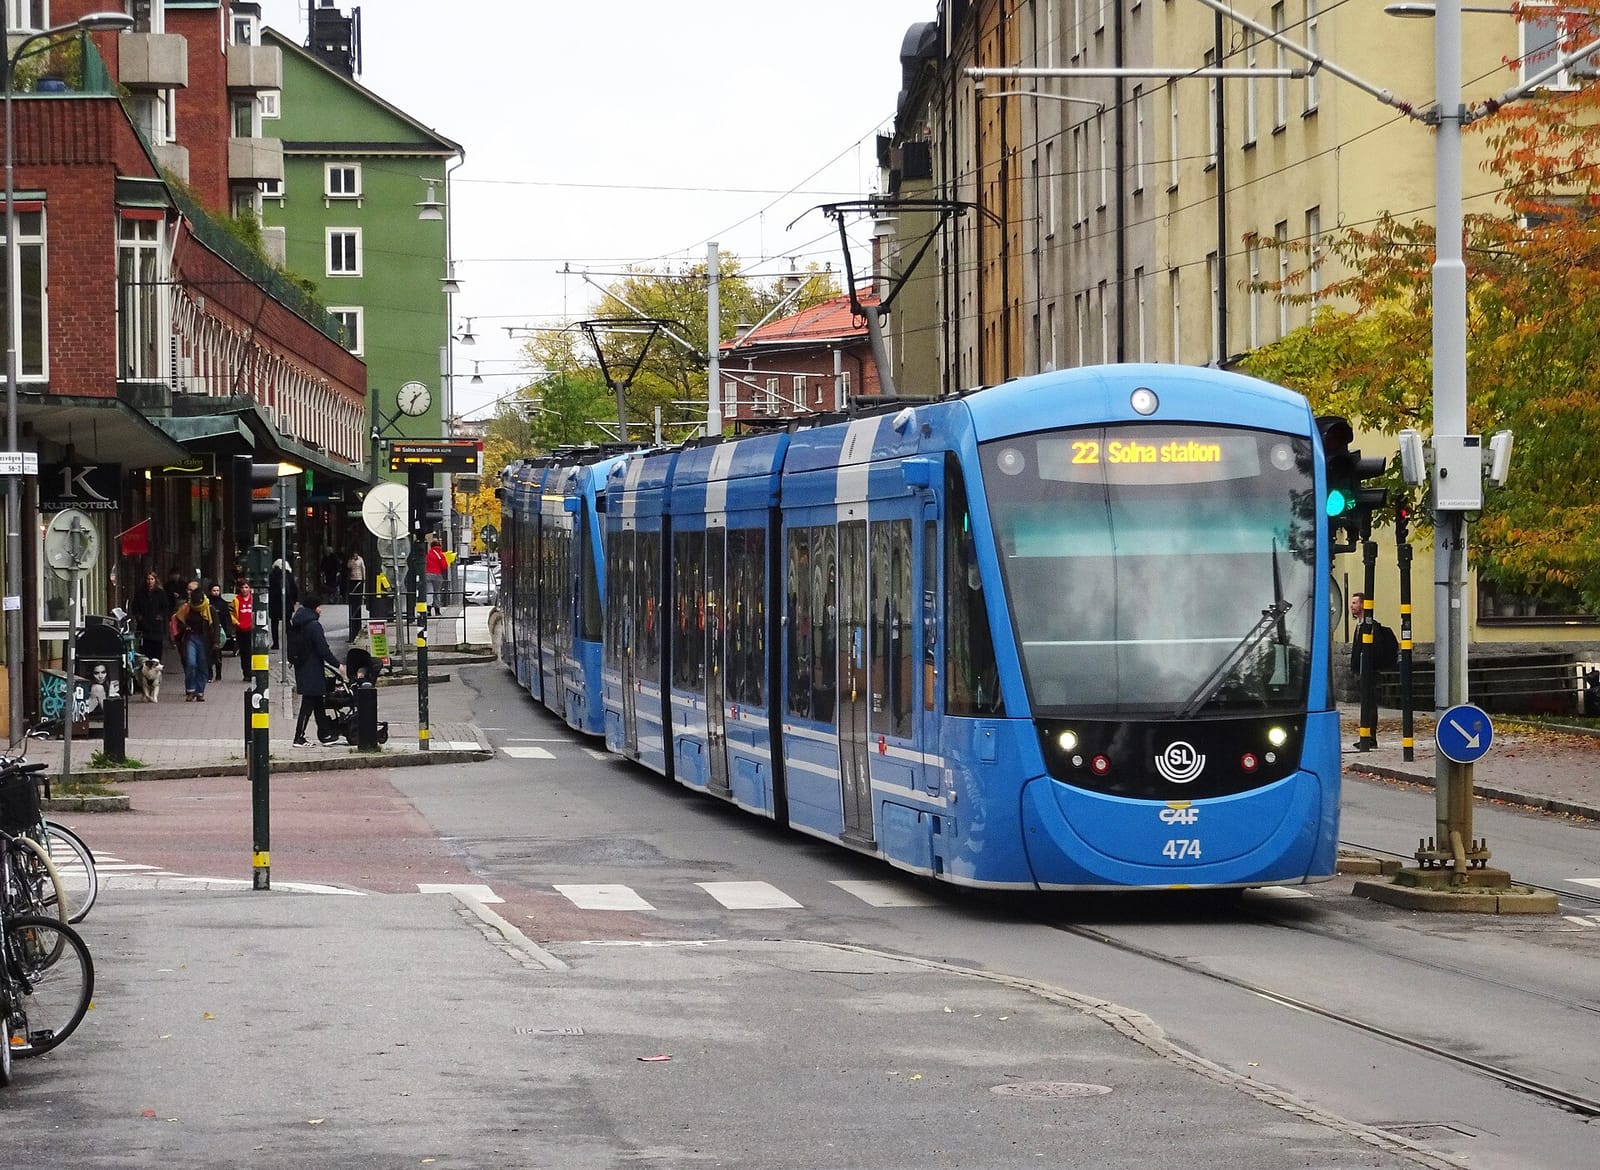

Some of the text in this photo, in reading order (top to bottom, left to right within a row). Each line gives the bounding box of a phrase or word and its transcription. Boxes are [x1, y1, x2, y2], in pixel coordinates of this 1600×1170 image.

[1071, 441, 1220, 464] 22 Solna station
[1169, 749, 1192, 765] SL
[1159, 808, 1199, 825] CAF
[1162, 839, 1201, 860] 474
